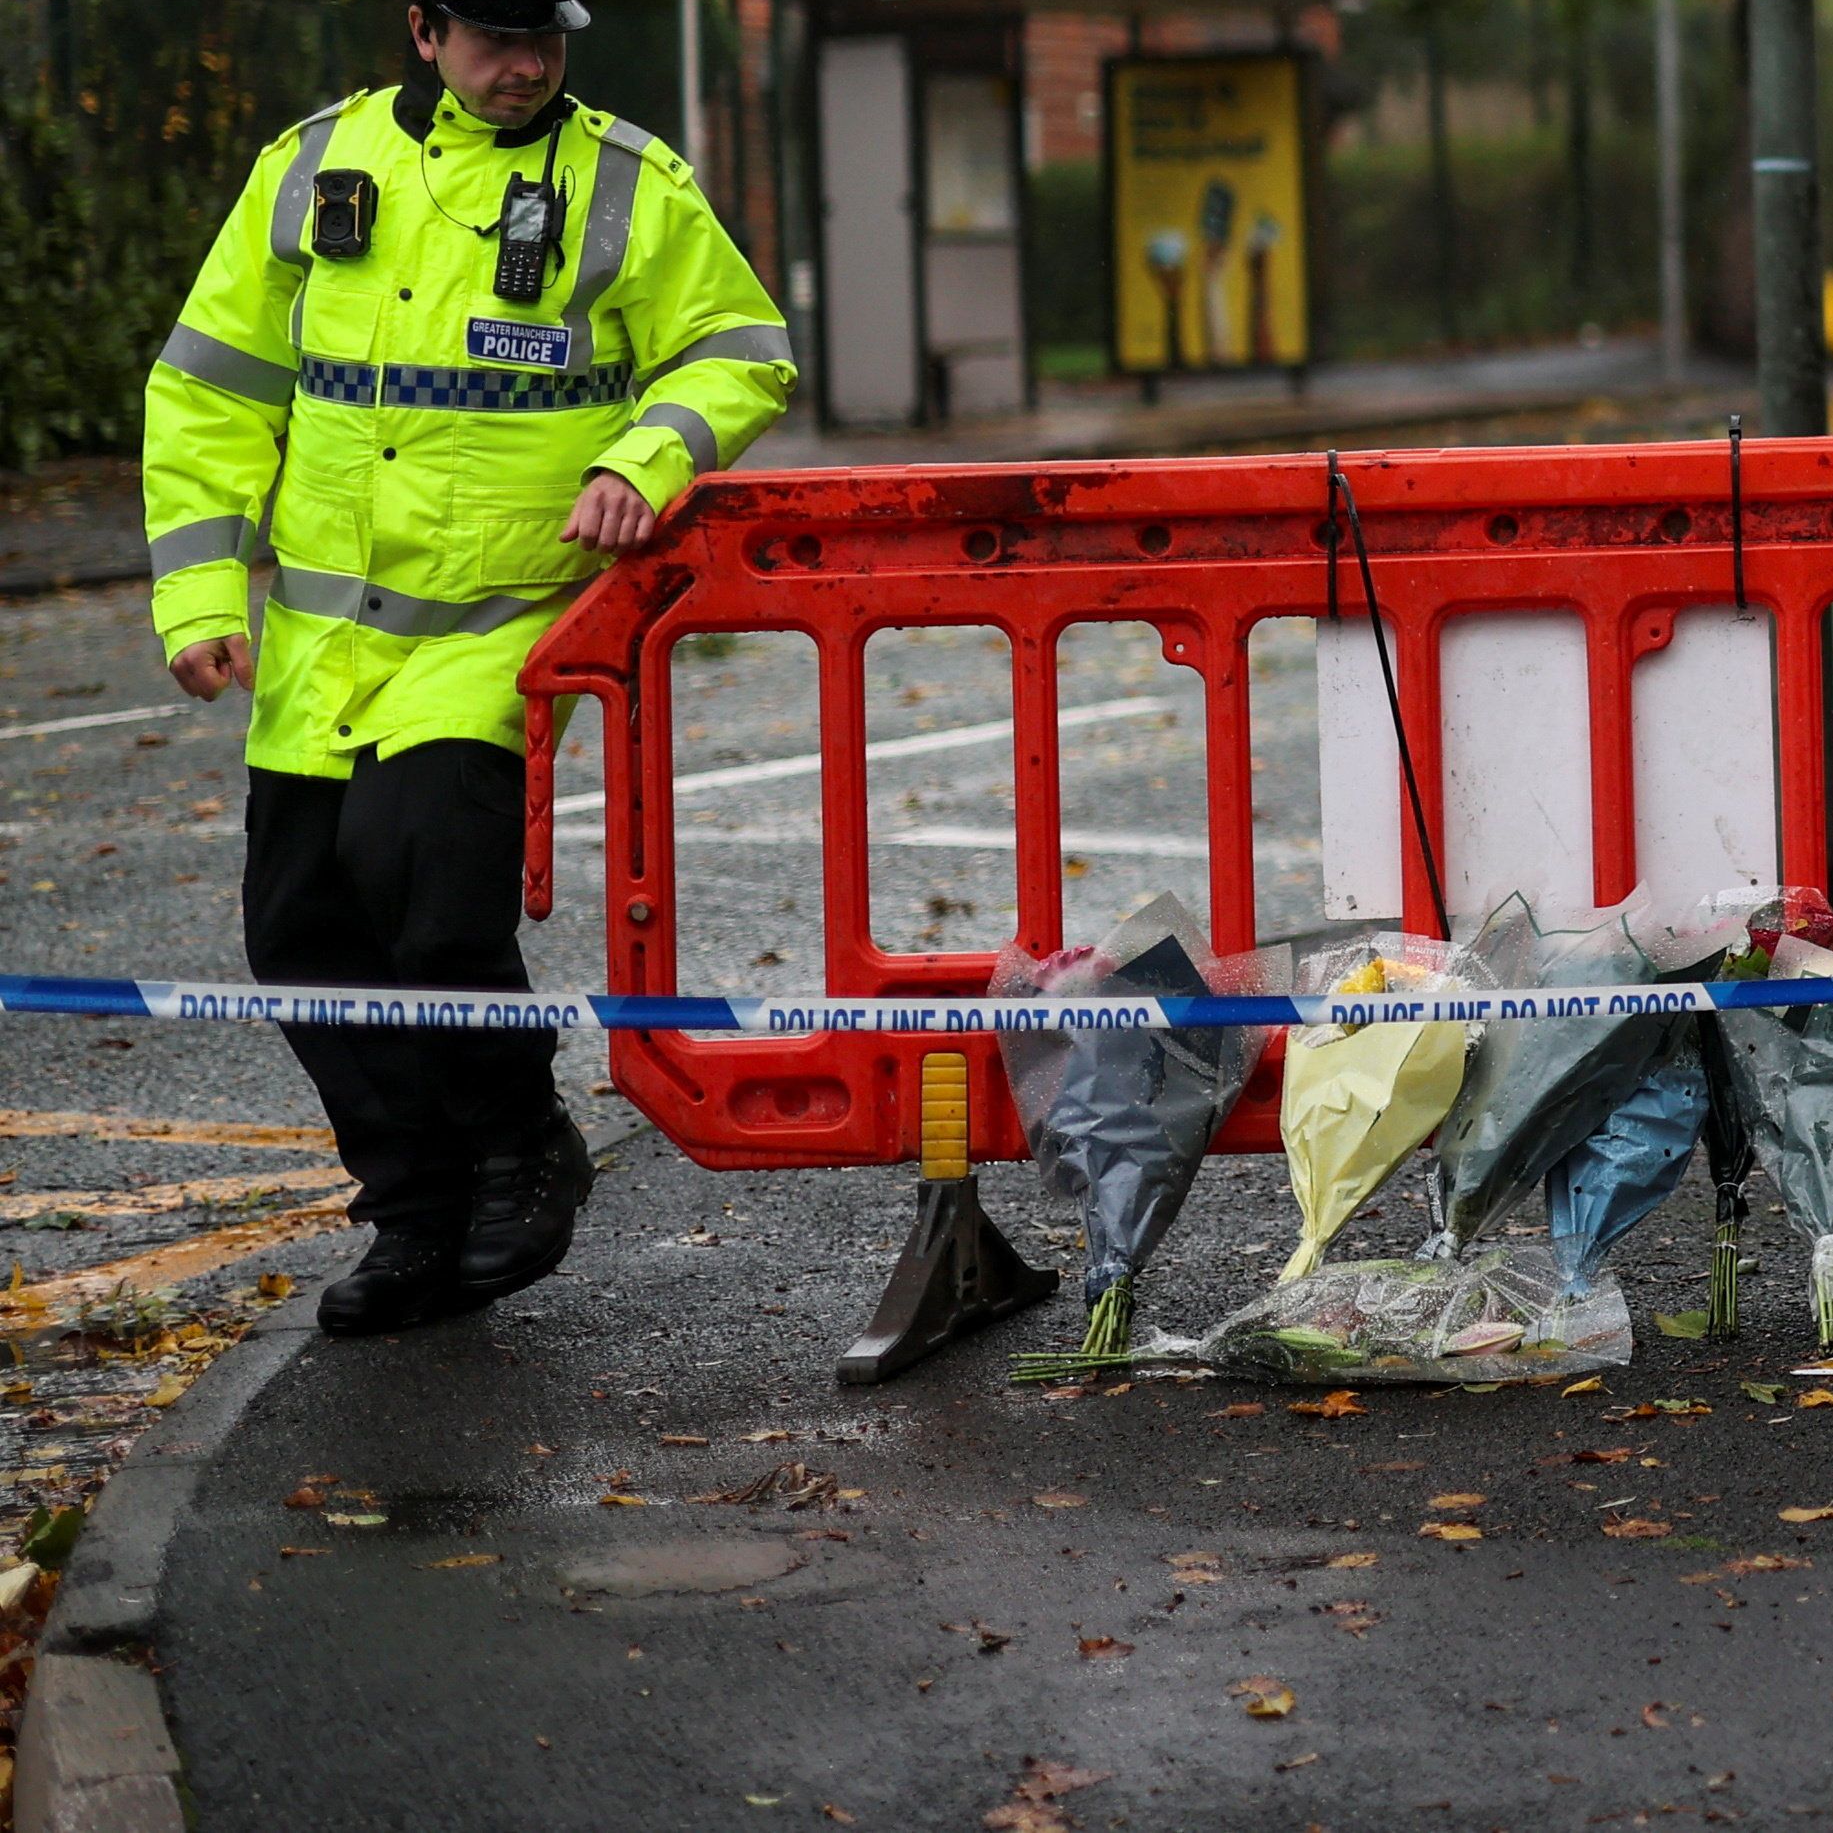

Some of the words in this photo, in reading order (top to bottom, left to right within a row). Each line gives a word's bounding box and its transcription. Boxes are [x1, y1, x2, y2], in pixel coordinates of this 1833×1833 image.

[472, 321, 510, 336] GREATER
[512, 326, 566, 342] MANCHESTER
[482, 336, 552, 362] POLICE
